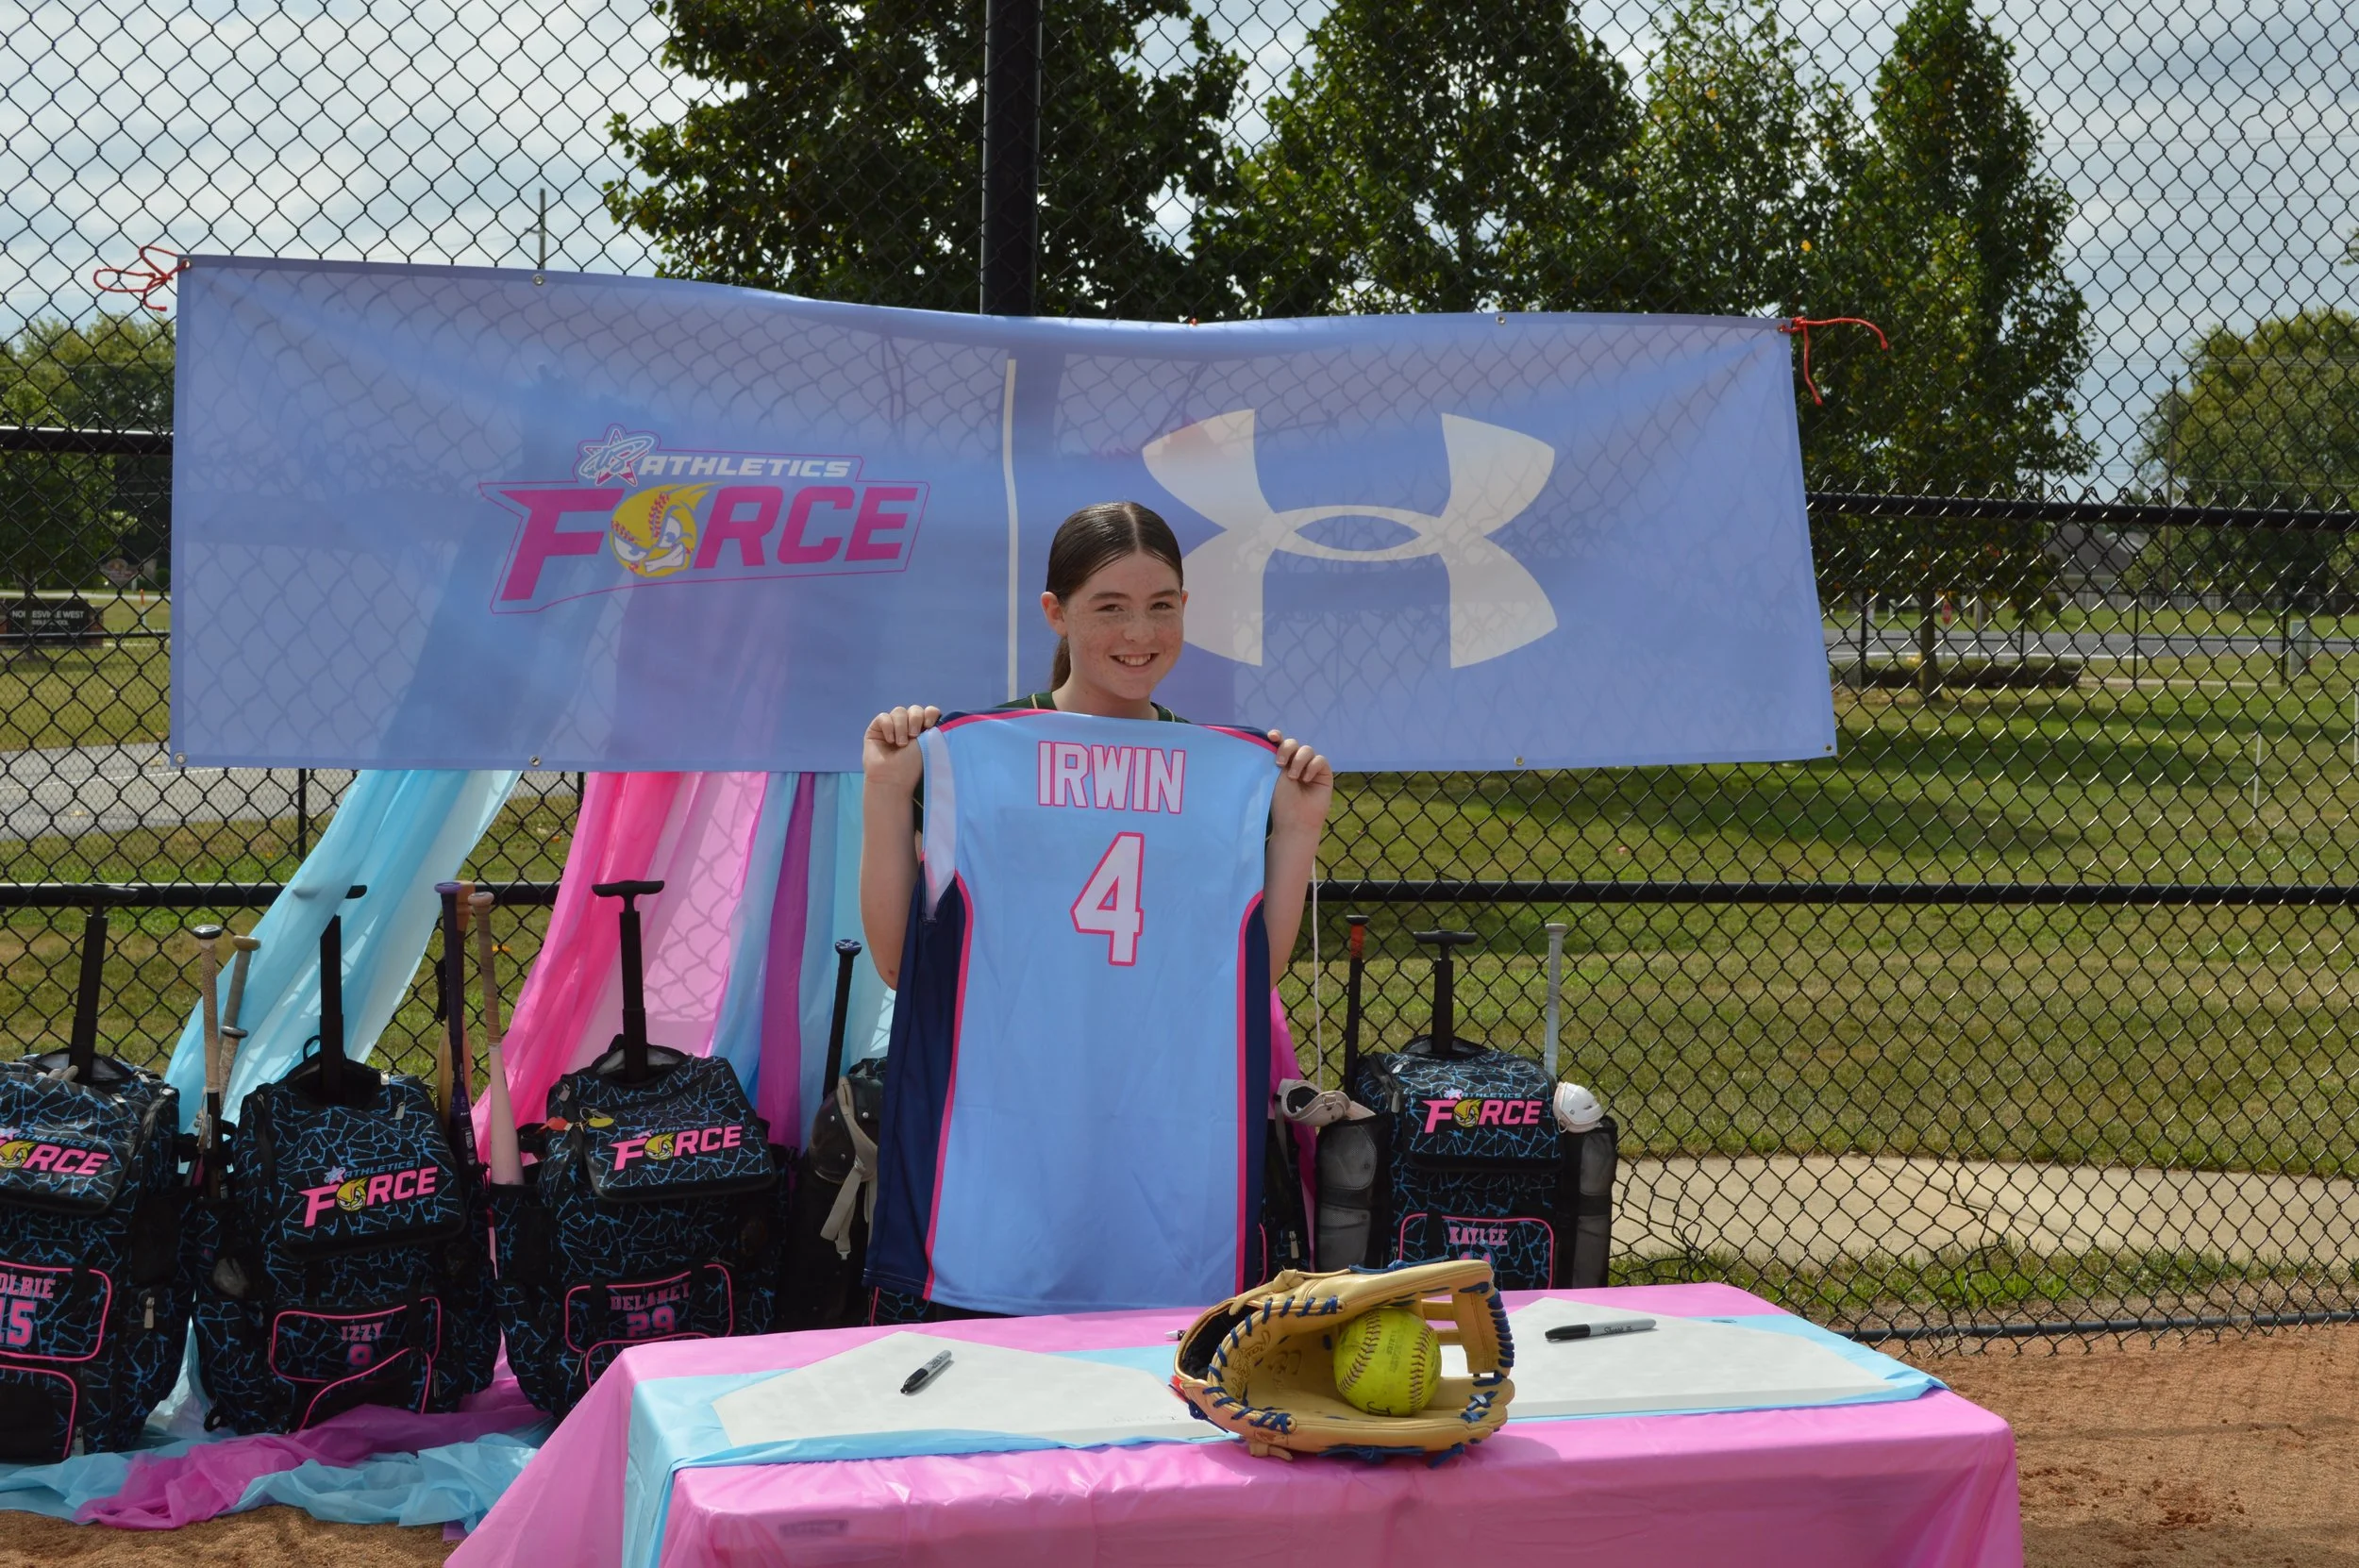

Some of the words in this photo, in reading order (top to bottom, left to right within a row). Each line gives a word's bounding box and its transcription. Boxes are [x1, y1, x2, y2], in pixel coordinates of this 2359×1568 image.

[638, 455, 851, 477] ATHLETICS
[1038, 741, 1186, 814] IRWIN
[1069, 831, 1145, 966] 4
[13, 1133, 92, 1148] ATHLETICS
[343, 1159, 415, 1178] ATHLETICS
[1448, 1226, 1508, 1245] KAYLEE
[341, 1322, 385, 1343] IZZY
